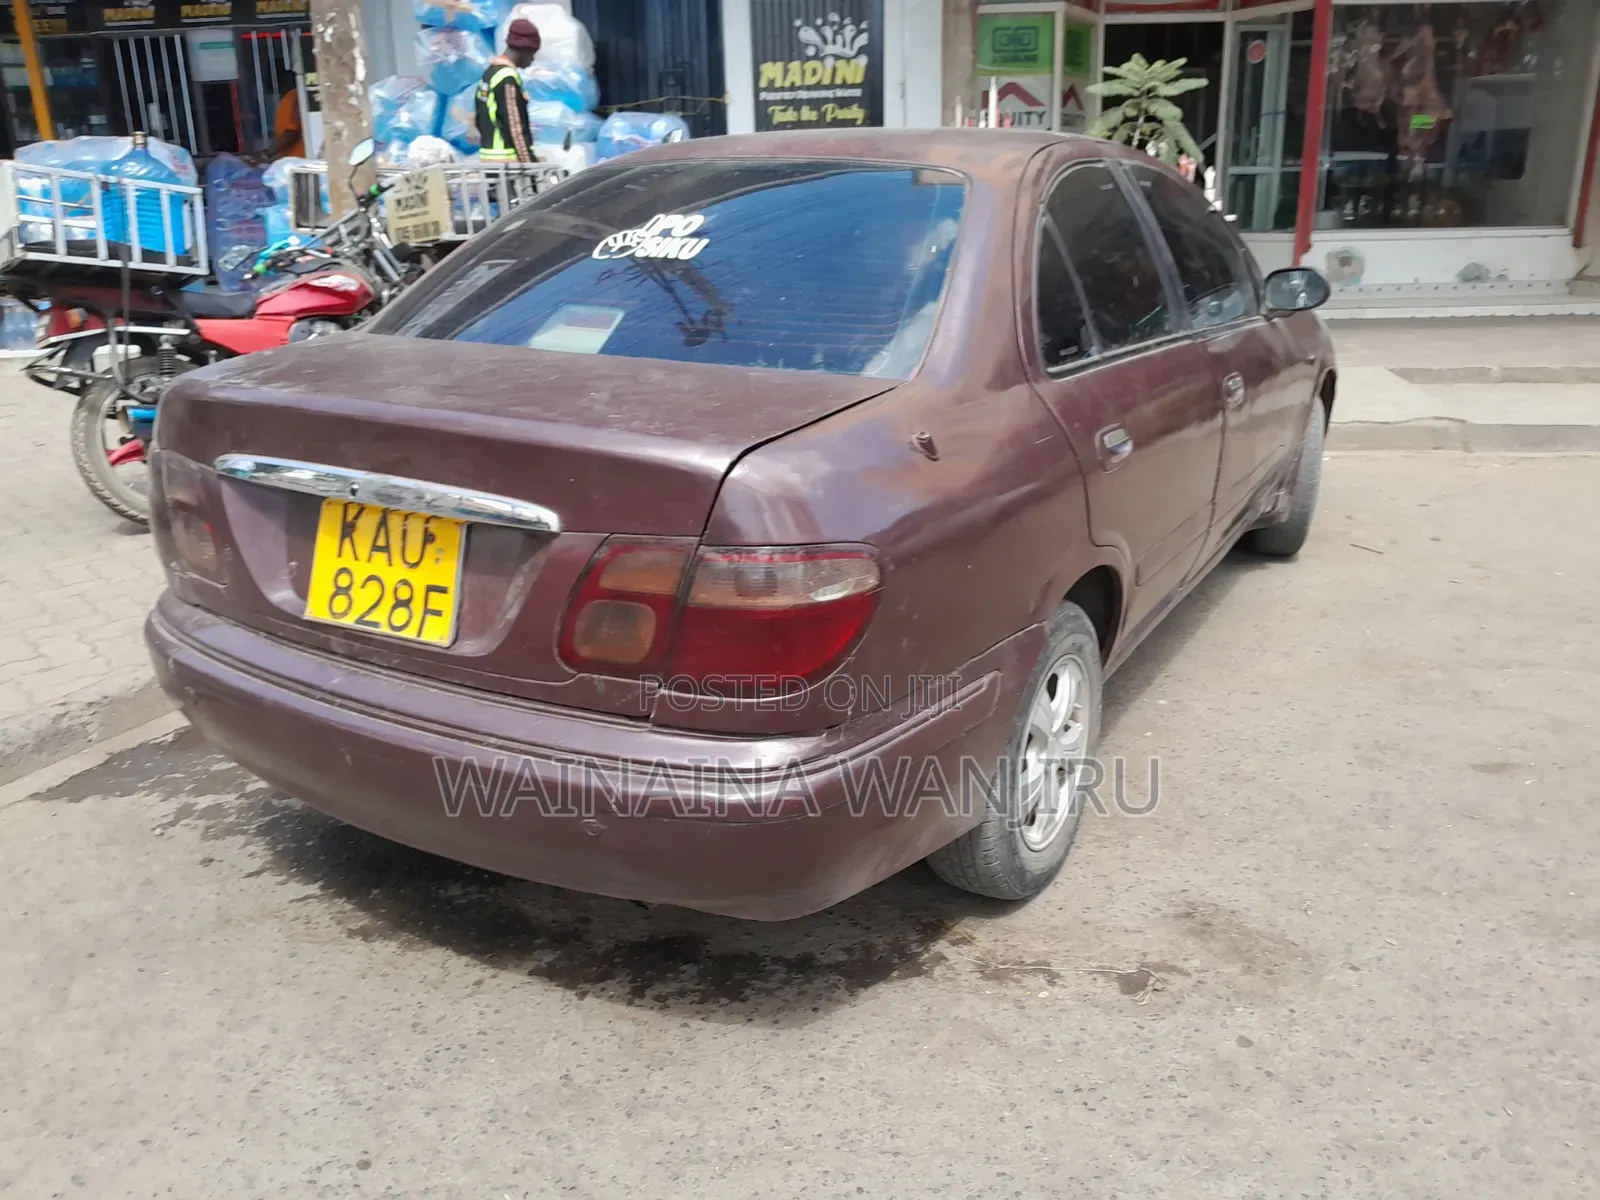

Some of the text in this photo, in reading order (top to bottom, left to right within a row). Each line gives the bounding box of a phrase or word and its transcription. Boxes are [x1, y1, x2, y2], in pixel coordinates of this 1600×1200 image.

[759, 55, 868, 88] MADINI
[634, 237, 710, 260] SIKU
[337, 502, 434, 568] KAU
[329, 567, 448, 638] 828F
